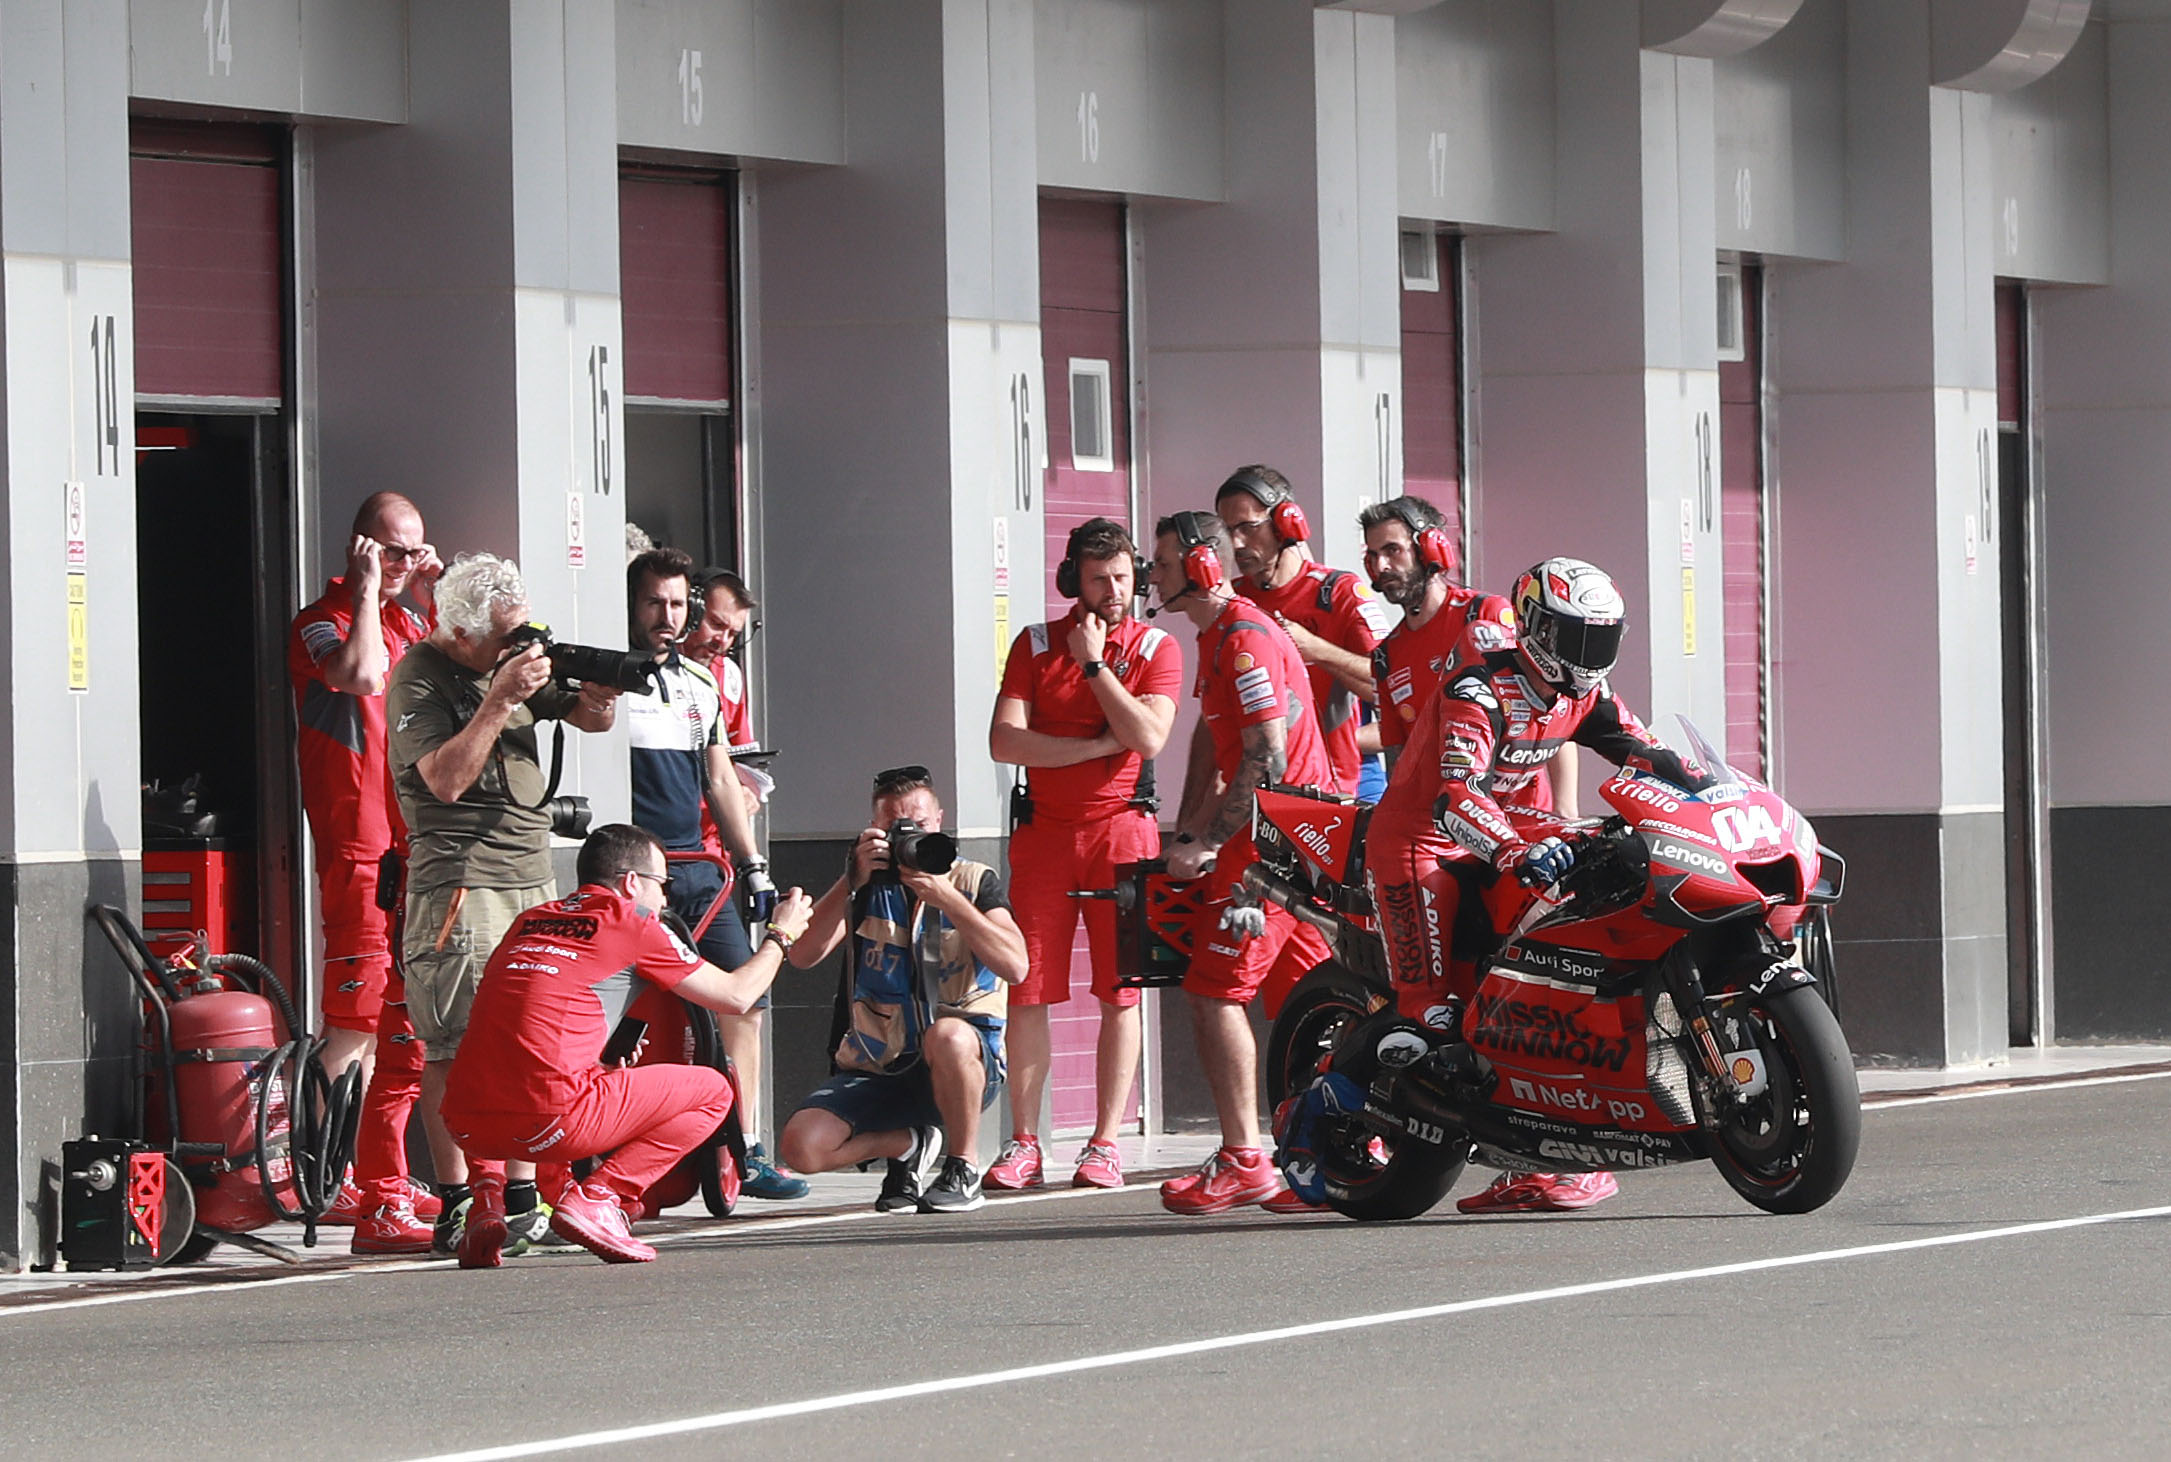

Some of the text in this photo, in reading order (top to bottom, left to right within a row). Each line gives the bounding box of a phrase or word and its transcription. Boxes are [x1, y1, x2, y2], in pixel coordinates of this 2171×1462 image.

[203, 0, 232, 77] 14
[677, 48, 702, 126] 15
[1077, 91, 1099, 164] 16
[1427, 131, 1448, 198] 17
[1733, 167, 1752, 231] 18
[2003, 197, 2019, 256] 19
[91, 315, 118, 477] 14
[589, 345, 611, 496] 15
[1011, 373, 1031, 512] 16
[1375, 393, 1389, 503] 17
[1694, 411, 1711, 533] 18
[1976, 427, 1991, 544] 19
[1458, 799, 1515, 840] DUCATI
[1619, 781, 1680, 813] riello
[1638, 776, 1691, 801] ADVANCE
[1293, 822, 1331, 856] riello
[1638, 818, 1718, 846] FRECCIAROSSA
[1652, 839, 1727, 874] Lenovo
[1711, 805, 1782, 854] 04
[545, 945, 578, 960] Sport
[1425, 908, 1443, 977] DAIKO
[1507, 1116, 1577, 1135] streparava
[1655, 1137, 1672, 1148] PAY
